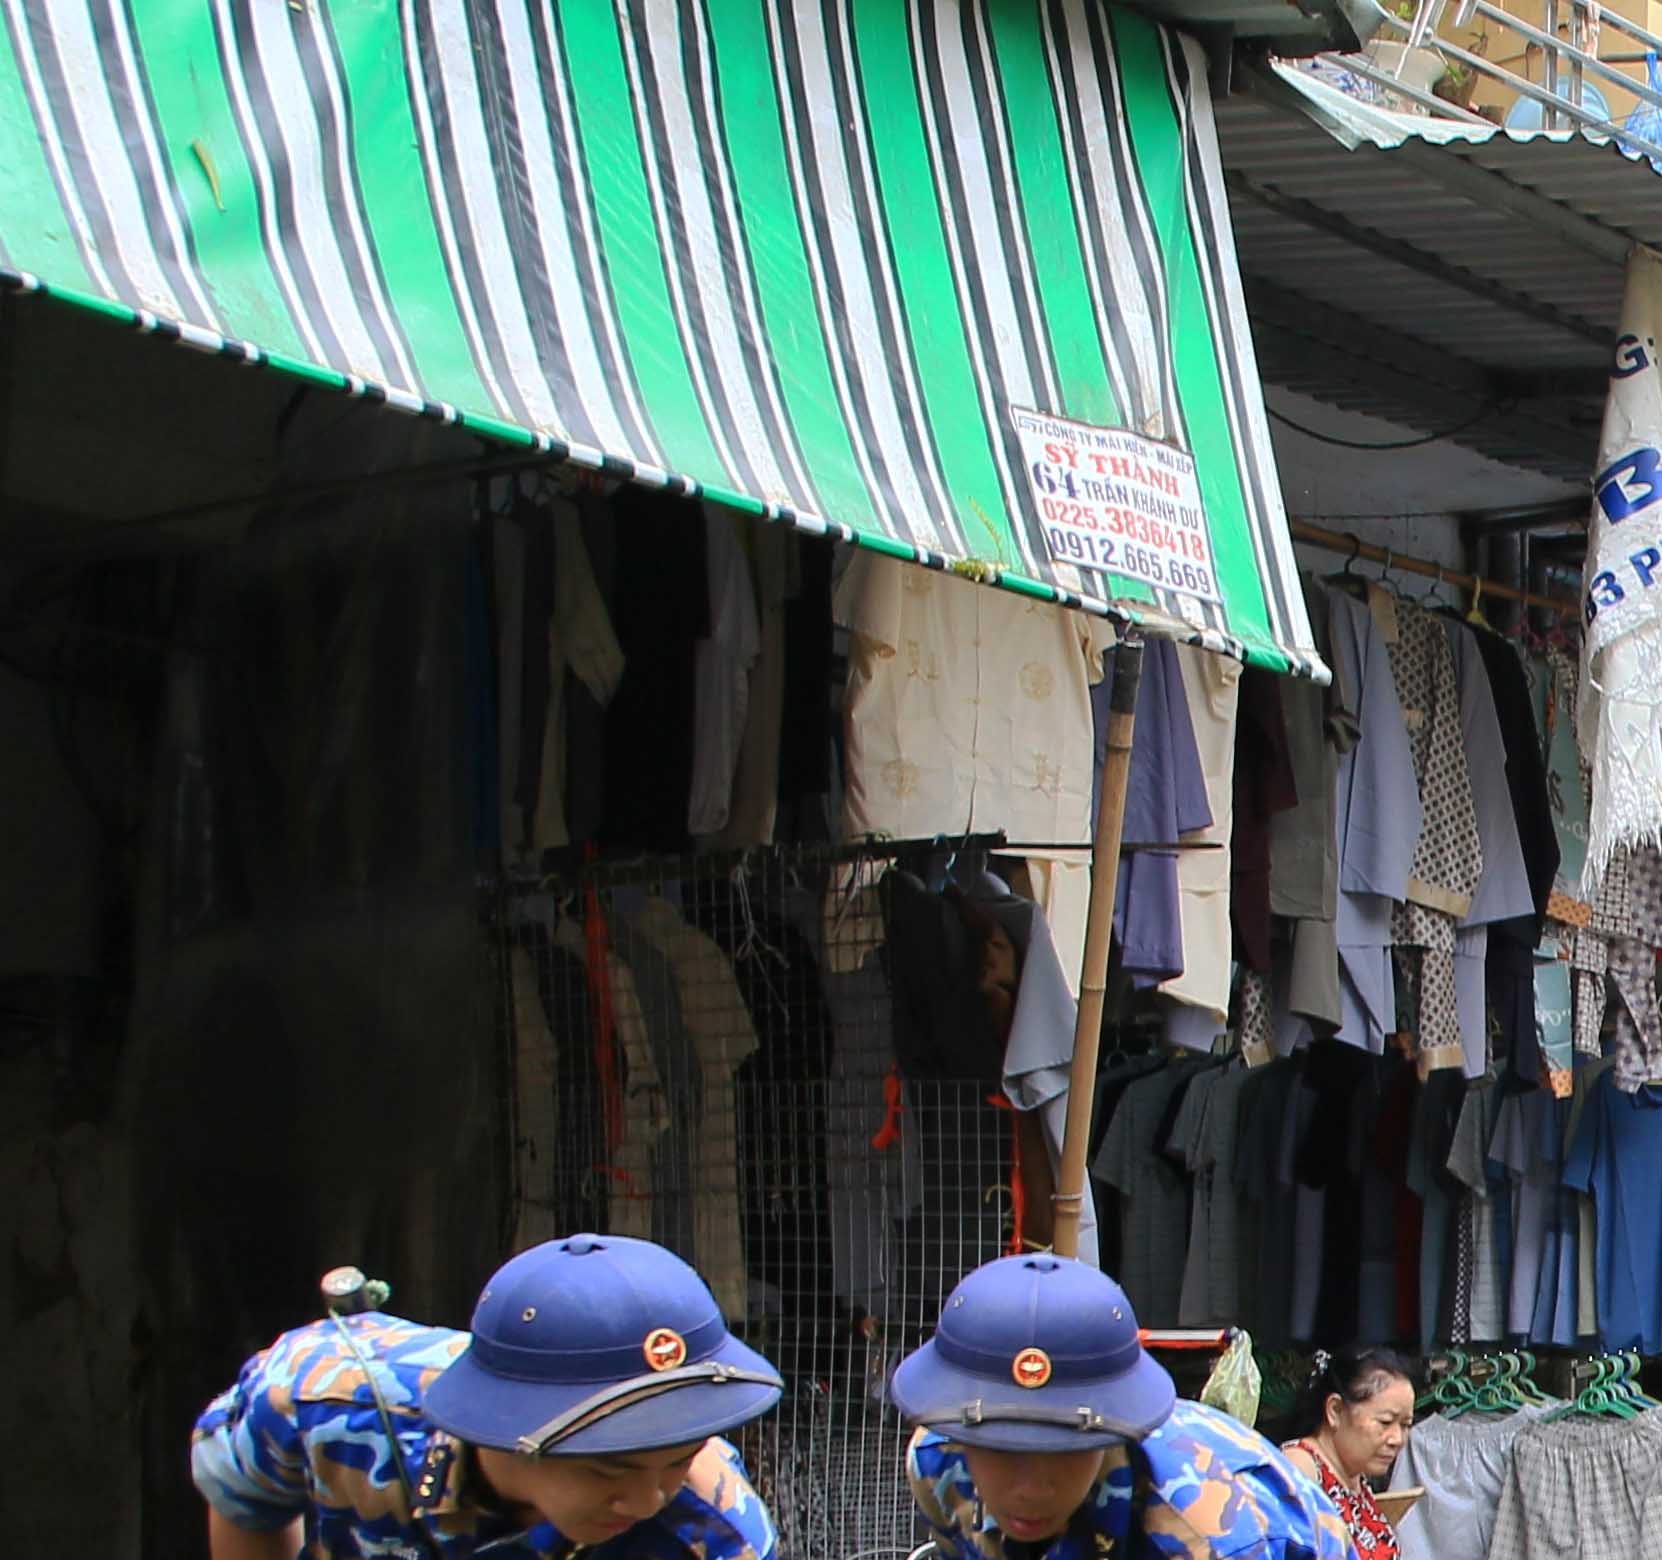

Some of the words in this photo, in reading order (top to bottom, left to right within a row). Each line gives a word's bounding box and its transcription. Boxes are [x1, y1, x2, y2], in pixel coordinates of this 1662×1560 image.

[1032, 460, 1081, 501] 64
[1081, 475, 1130, 506] TRẦN
[1131, 487, 1177, 524] KHÁNH
[1087, 451, 1181, 498] THÀNH
[1042, 497, 1205, 561] 0225.3836418
[1050, 527, 1212, 595] 0912.665.669
